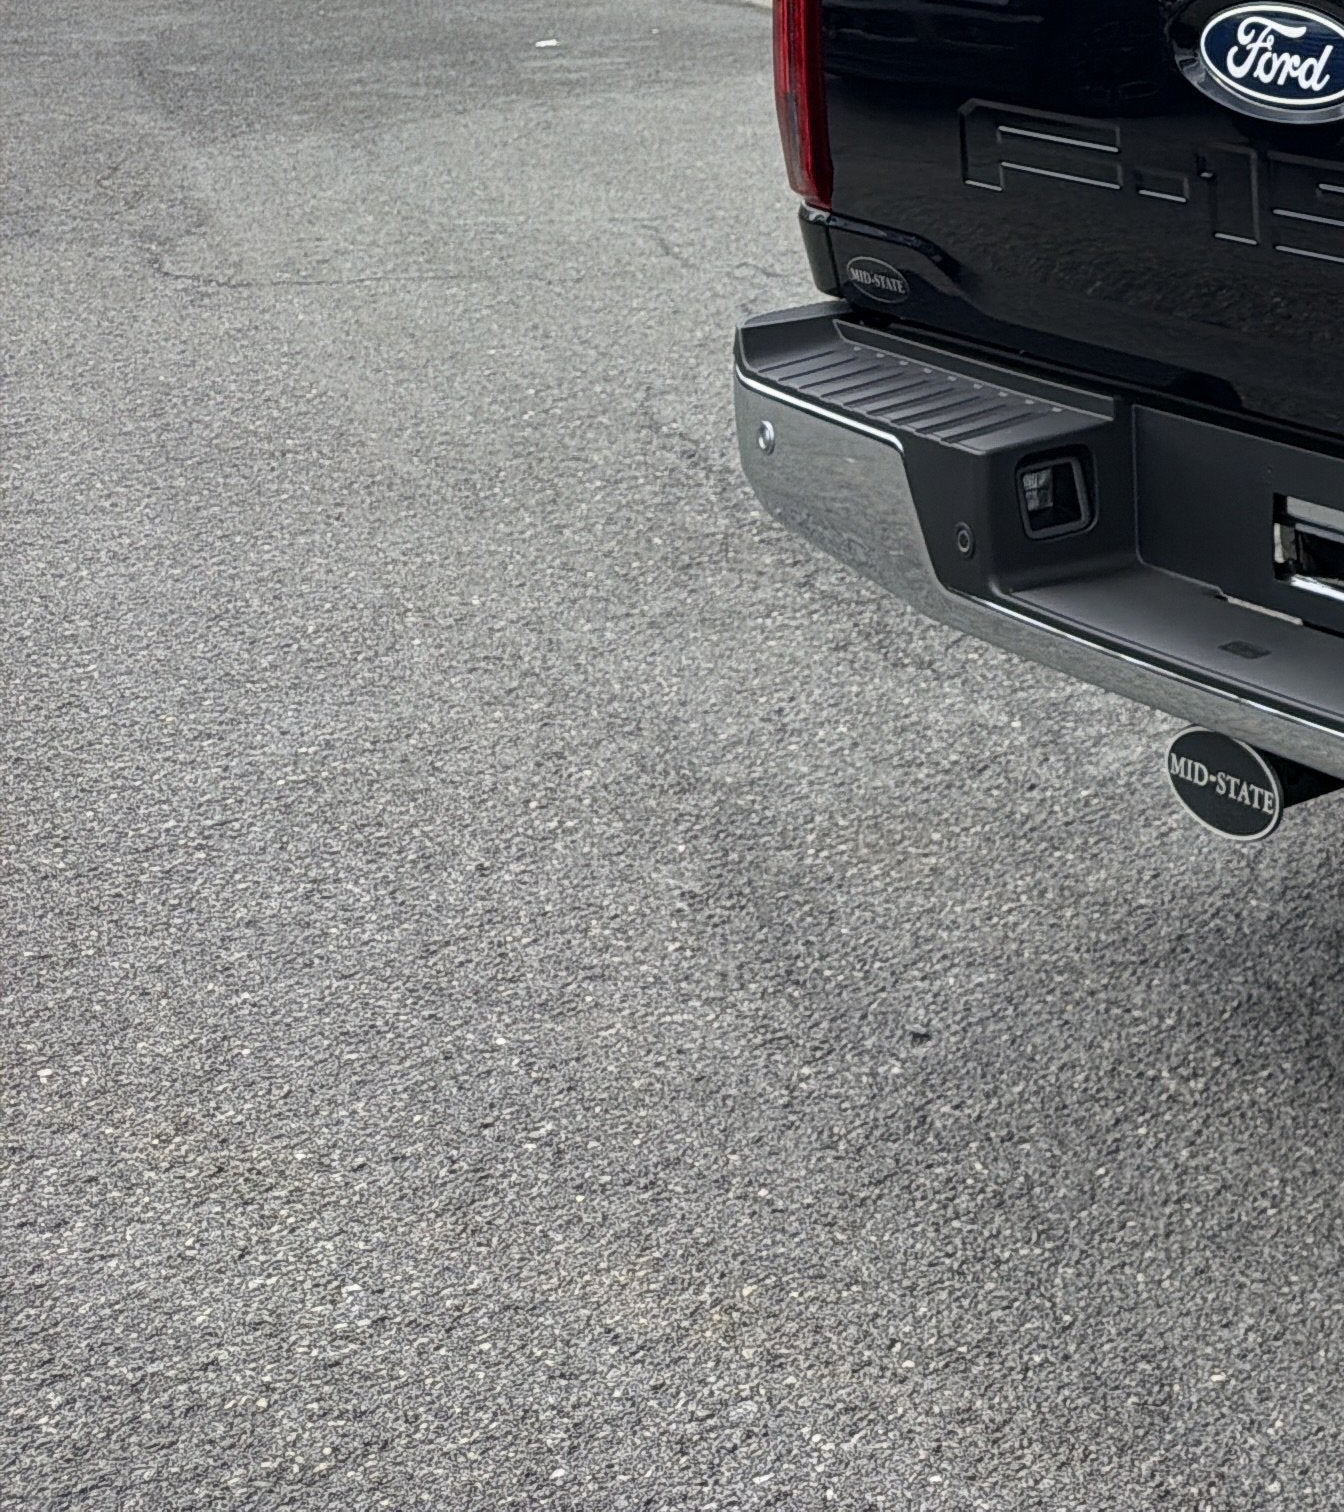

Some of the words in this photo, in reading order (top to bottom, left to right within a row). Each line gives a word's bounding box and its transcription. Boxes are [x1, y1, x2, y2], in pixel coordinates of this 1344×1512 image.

[1226, 16, 1334, 92] Ford
[850, 267, 906, 295] MID-STATE
[1169, 753, 1275, 815] MID-STATE
